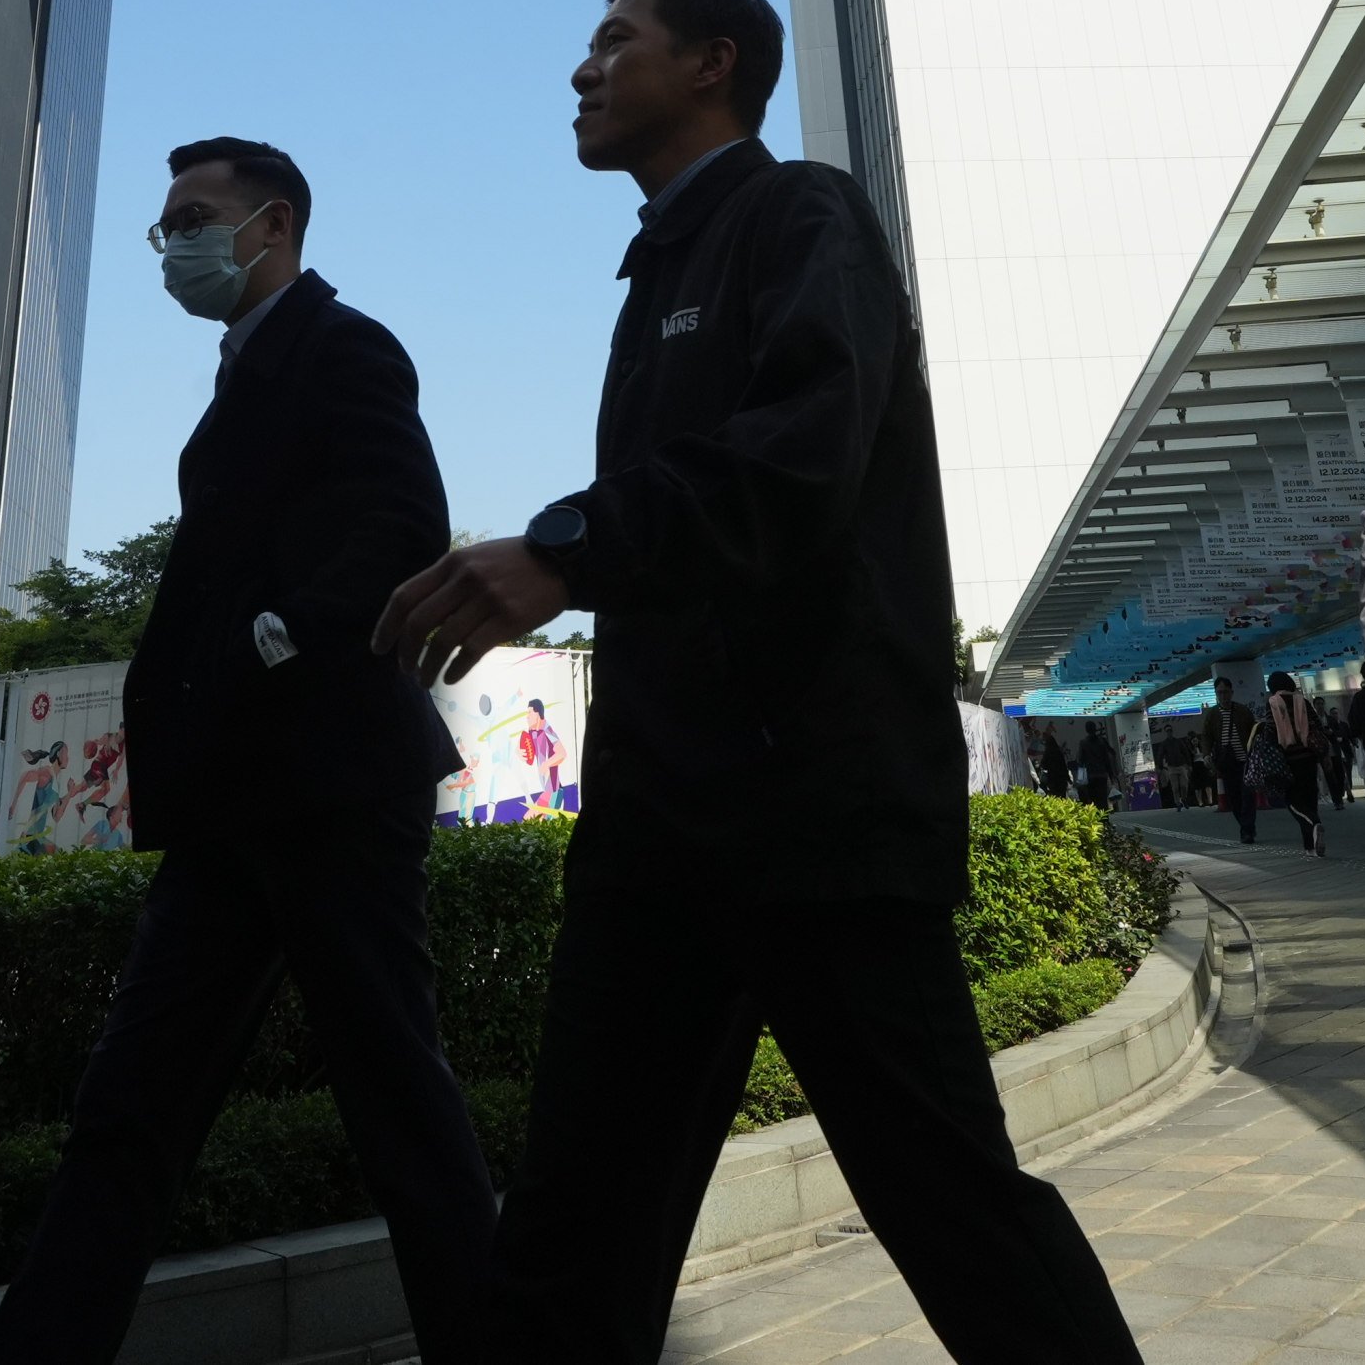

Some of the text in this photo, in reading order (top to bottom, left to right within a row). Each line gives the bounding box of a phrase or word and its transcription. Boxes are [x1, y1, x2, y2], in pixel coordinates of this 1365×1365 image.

[662, 306, 701, 339] VANS
[1319, 467, 1365, 476] 12.12.2024
[1285, 495, 1327, 503] 12.12.2024
[1312, 515, 1350, 523] 14.2.2025
